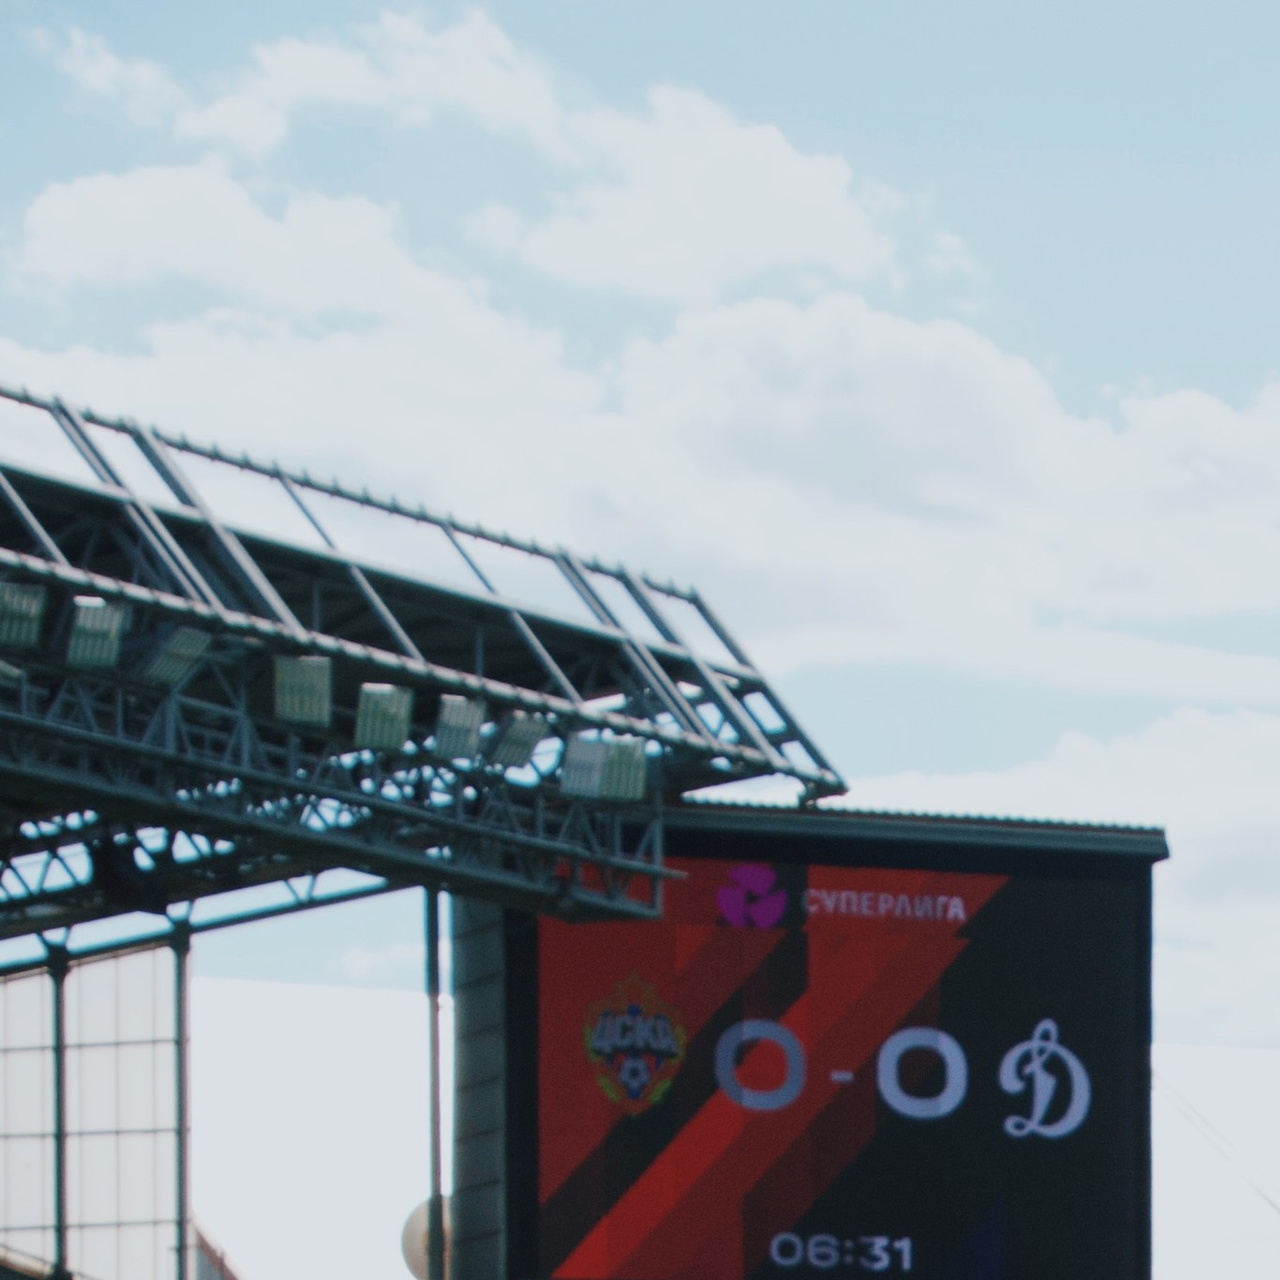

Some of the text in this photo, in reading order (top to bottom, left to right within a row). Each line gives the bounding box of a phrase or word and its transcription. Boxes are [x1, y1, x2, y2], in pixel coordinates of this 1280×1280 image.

[804, 888, 968, 923] СУПЕРЛИГА
[588, 1010, 680, 1058] ЦСКА
[714, 1018, 807, 1112] 0
[877, 1026, 969, 1120] 0
[769, 1231, 913, 1272] 06:31
